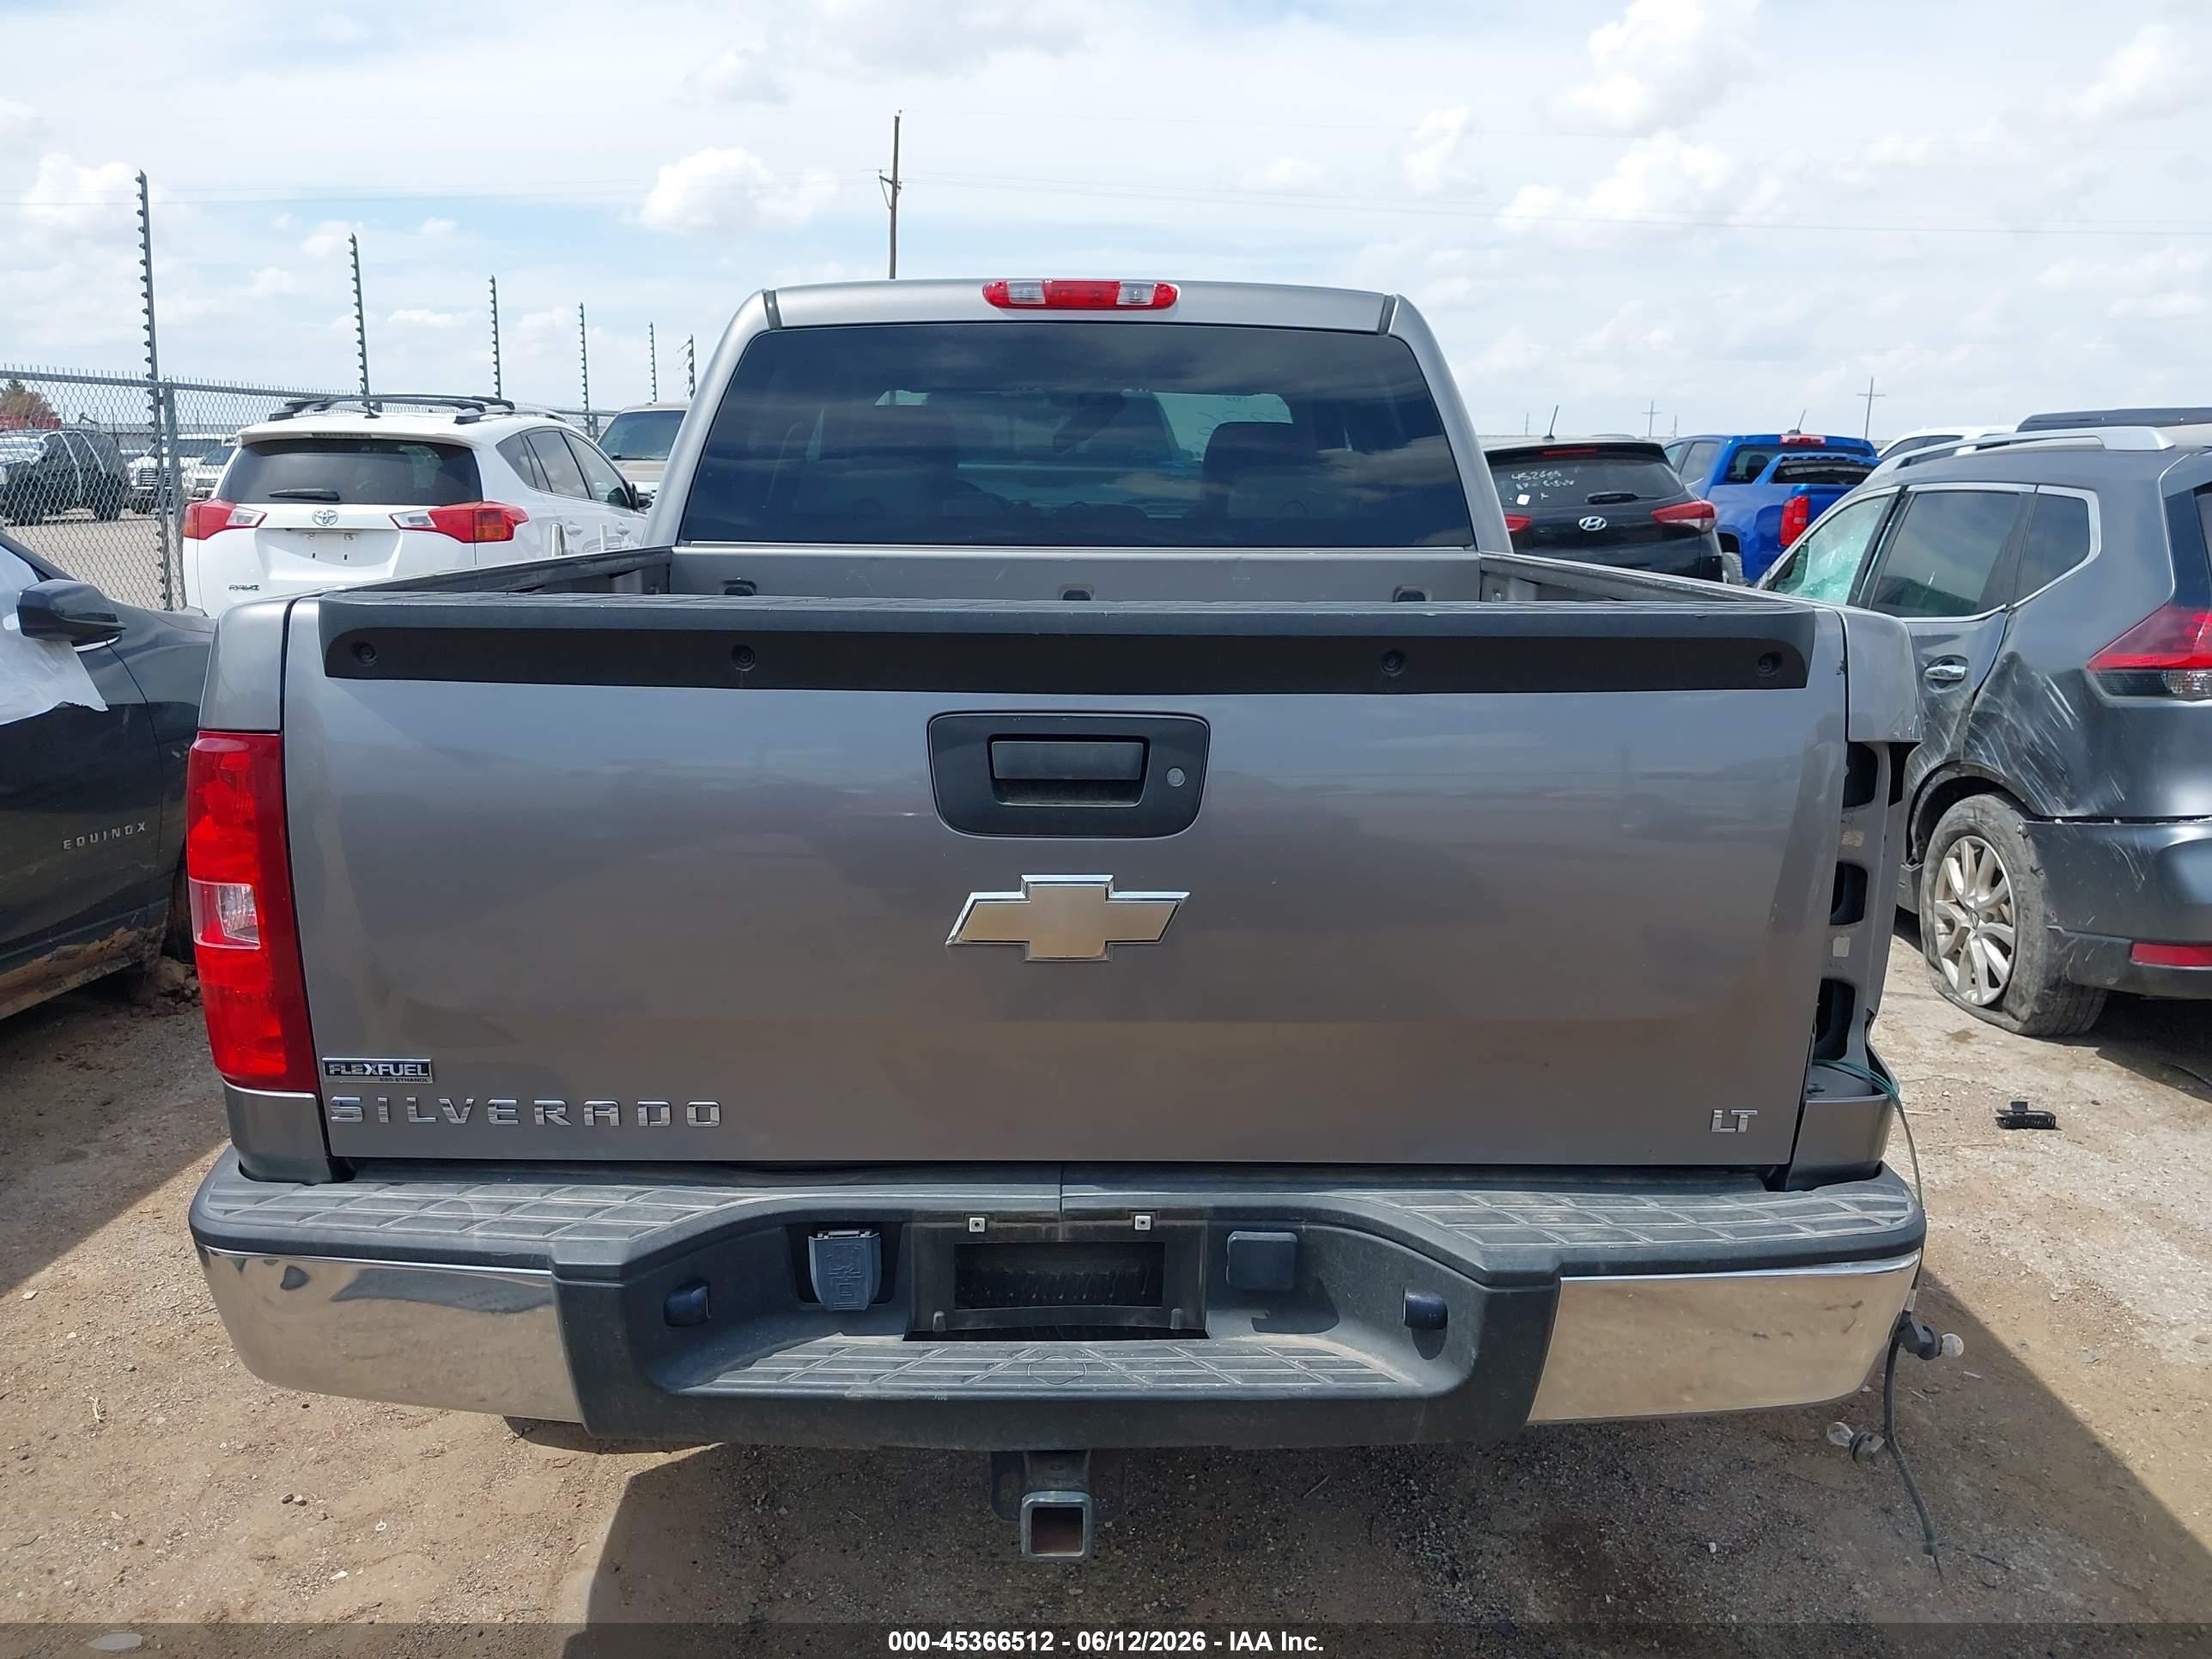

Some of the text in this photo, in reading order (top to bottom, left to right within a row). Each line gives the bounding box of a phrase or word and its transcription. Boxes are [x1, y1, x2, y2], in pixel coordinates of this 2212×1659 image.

[63, 821, 146, 850] EQUINOX
[328, 1063, 429, 1076] FLEXFUEL
[329, 1096, 722, 1127] SILVERADO
[1711, 1109, 1759, 1133] LT
